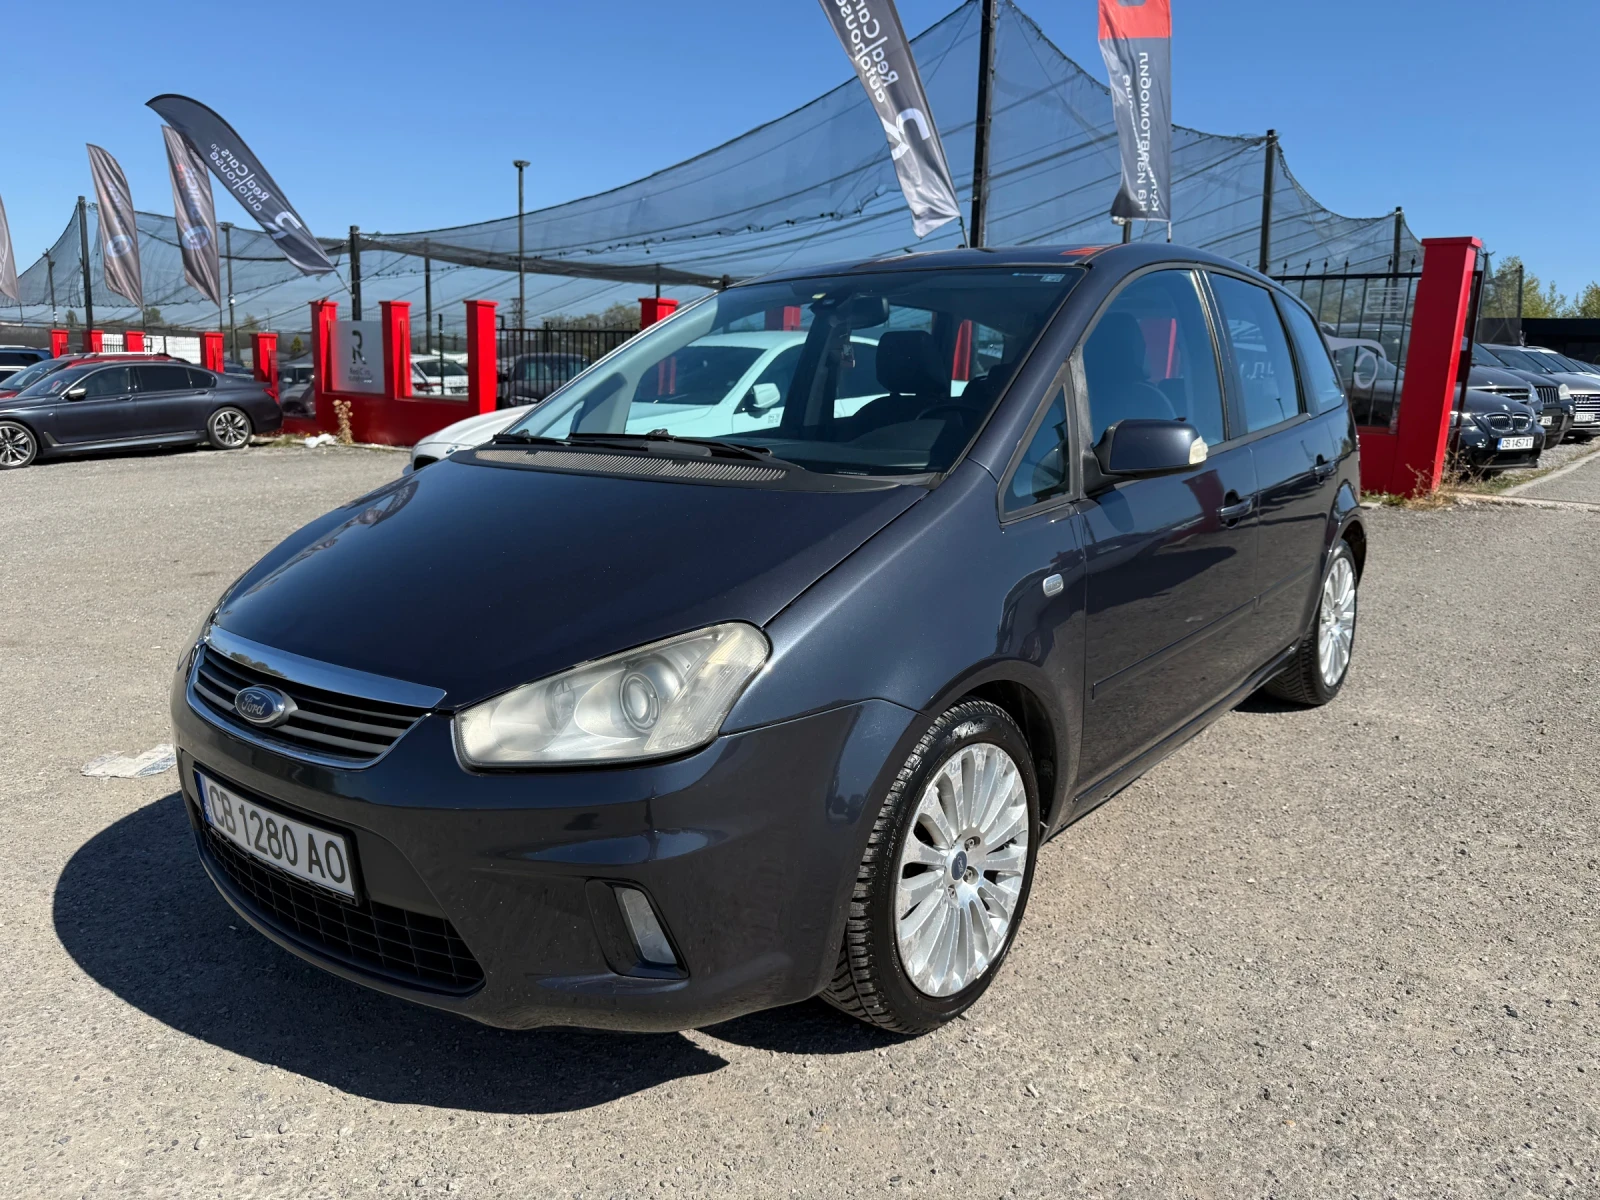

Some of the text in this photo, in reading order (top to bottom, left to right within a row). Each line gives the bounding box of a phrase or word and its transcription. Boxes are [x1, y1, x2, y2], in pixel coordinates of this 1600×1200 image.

[239, 692, 266, 716] Ford
[209, 785, 347, 884] CB 1280 AO
